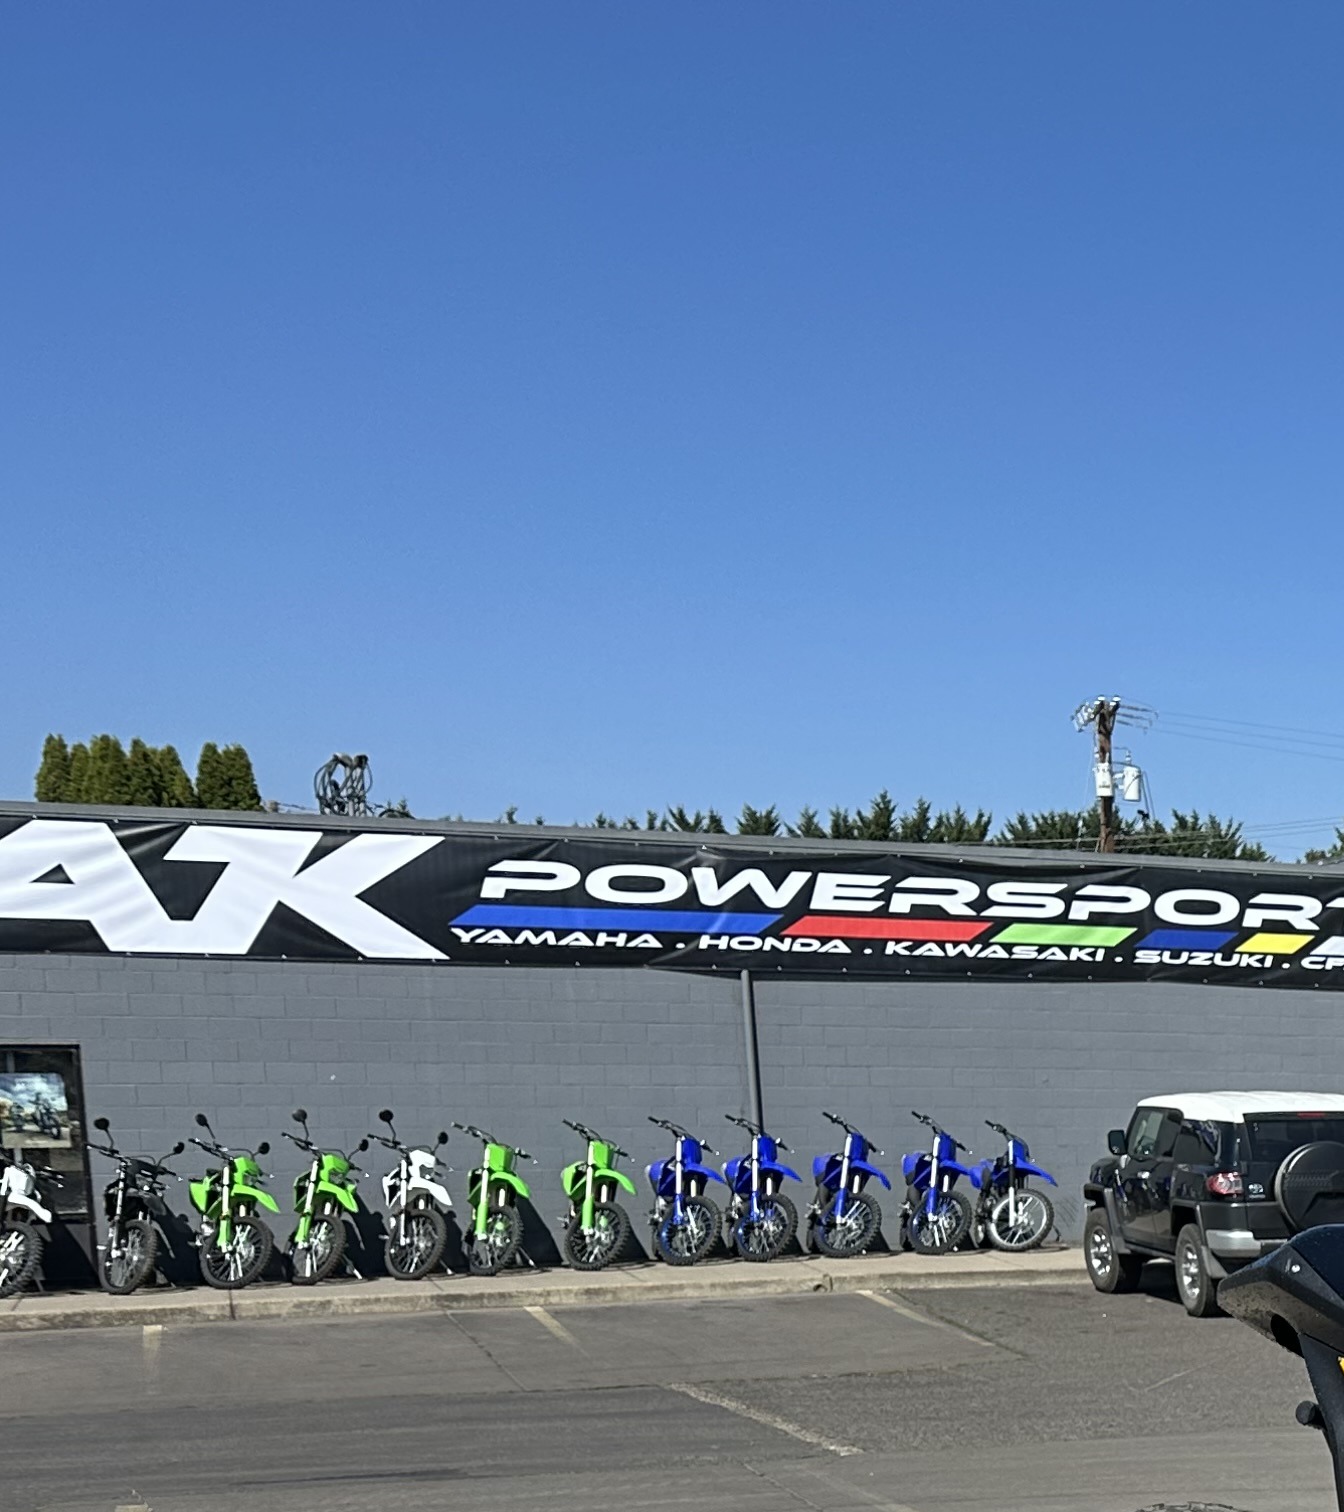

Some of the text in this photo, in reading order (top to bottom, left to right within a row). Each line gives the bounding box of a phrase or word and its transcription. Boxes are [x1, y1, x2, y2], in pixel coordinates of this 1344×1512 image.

[0, 819, 450, 960] AK
[450, 927, 664, 950] YAMAHA
[698, 934, 852, 954] HONDA
[885, 940, 1106, 963] KAWASAKI
[1133, 950, 1274, 969] SUZUKI
